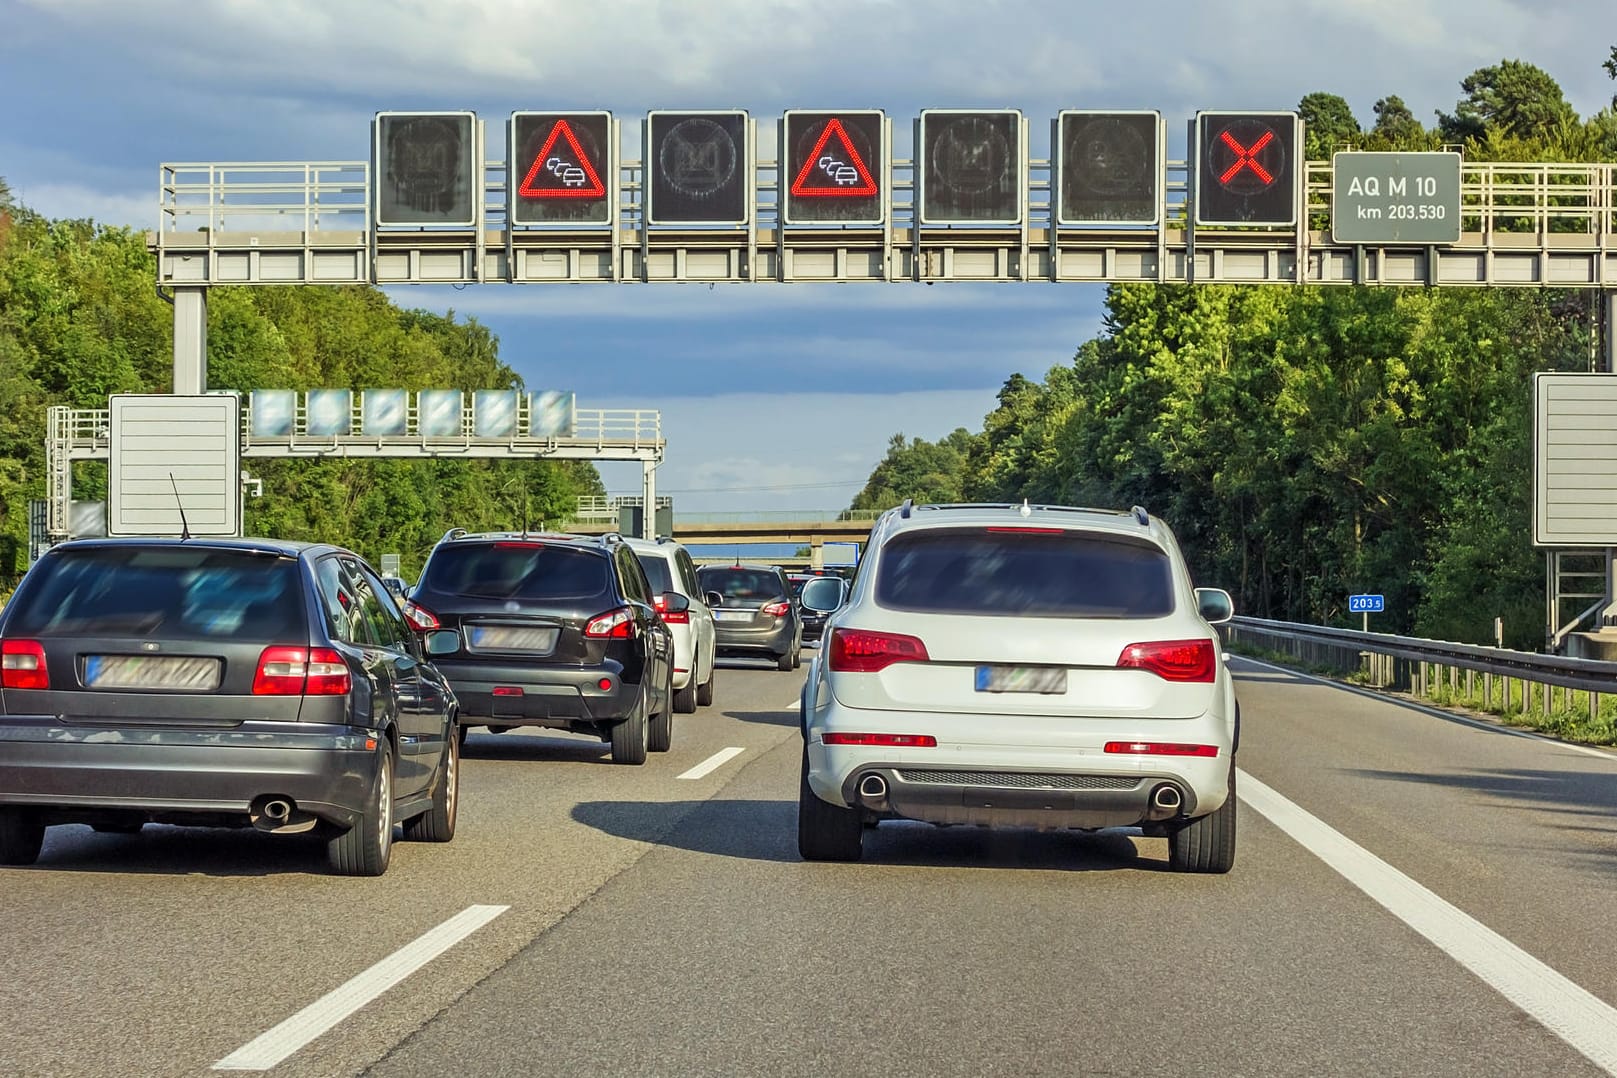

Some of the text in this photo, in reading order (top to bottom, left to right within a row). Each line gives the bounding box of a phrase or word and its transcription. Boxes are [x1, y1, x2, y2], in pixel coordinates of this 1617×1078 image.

[1348, 177, 1436, 196] AQ M 10
[1357, 205, 1381, 219] km
